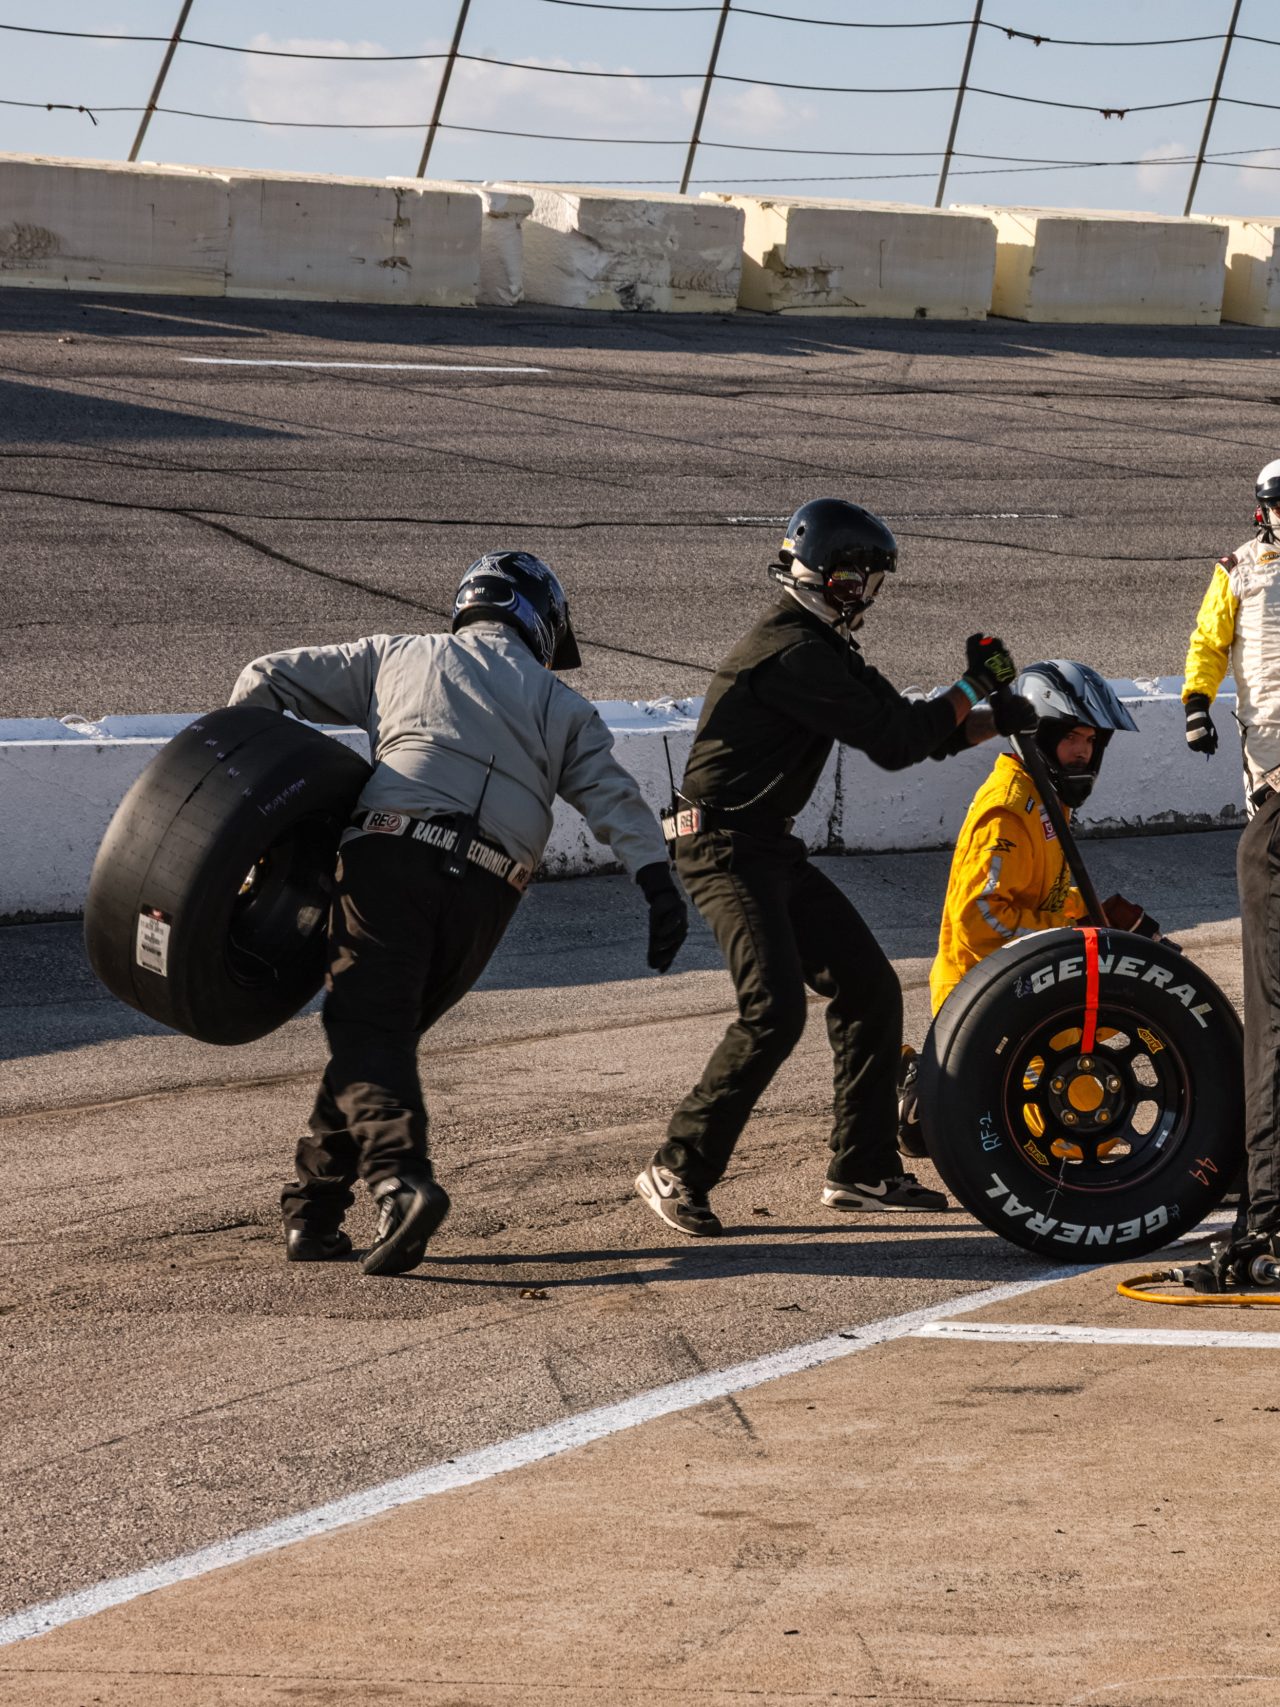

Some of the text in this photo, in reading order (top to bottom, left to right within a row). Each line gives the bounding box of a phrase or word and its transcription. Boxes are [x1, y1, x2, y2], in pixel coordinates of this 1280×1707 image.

[412, 823, 457, 850] RACING
[1030, 954, 1213, 1029] GENERAL
[985, 1172, 1169, 1246] GENERAL
